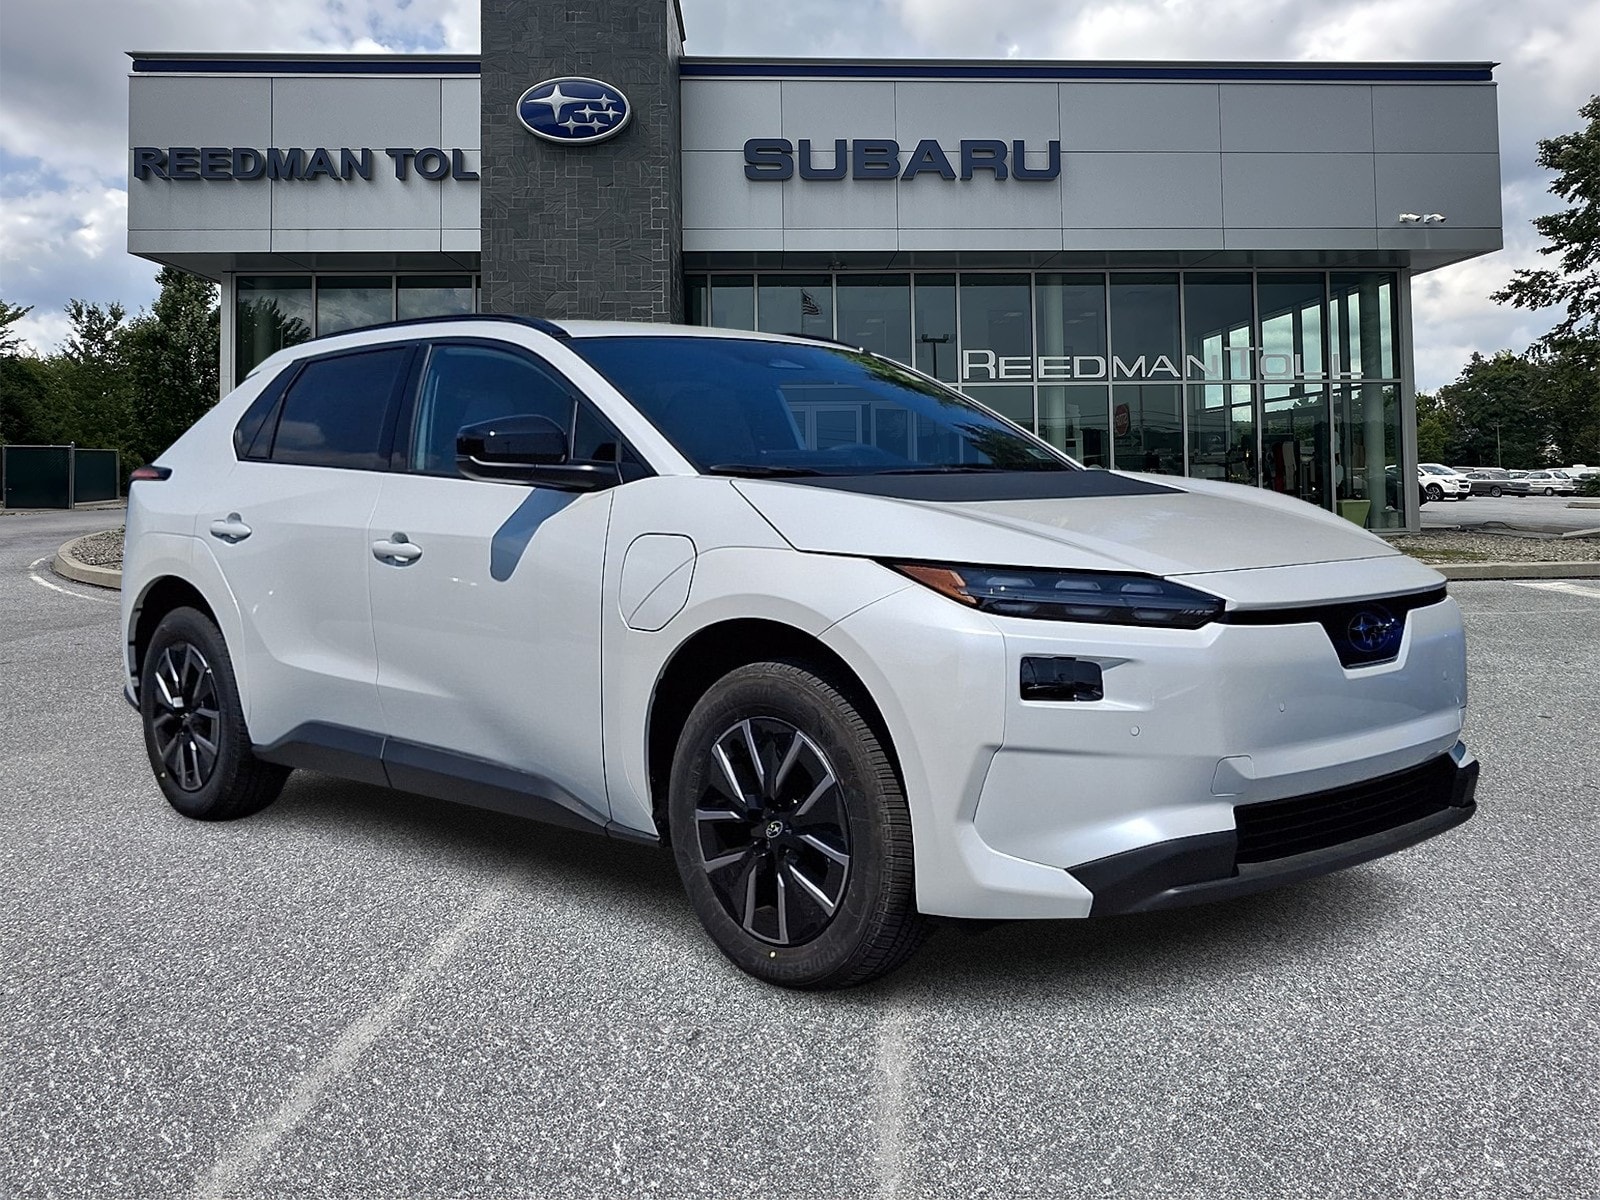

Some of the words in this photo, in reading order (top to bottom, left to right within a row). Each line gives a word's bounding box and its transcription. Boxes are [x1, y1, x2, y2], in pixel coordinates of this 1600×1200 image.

[133, 147, 374, 181] REEDMAN
[743, 137, 1062, 181] SUBARU
[962, 349, 1219, 380] REEDMAN
[1223, 346, 1364, 377] TOLL
